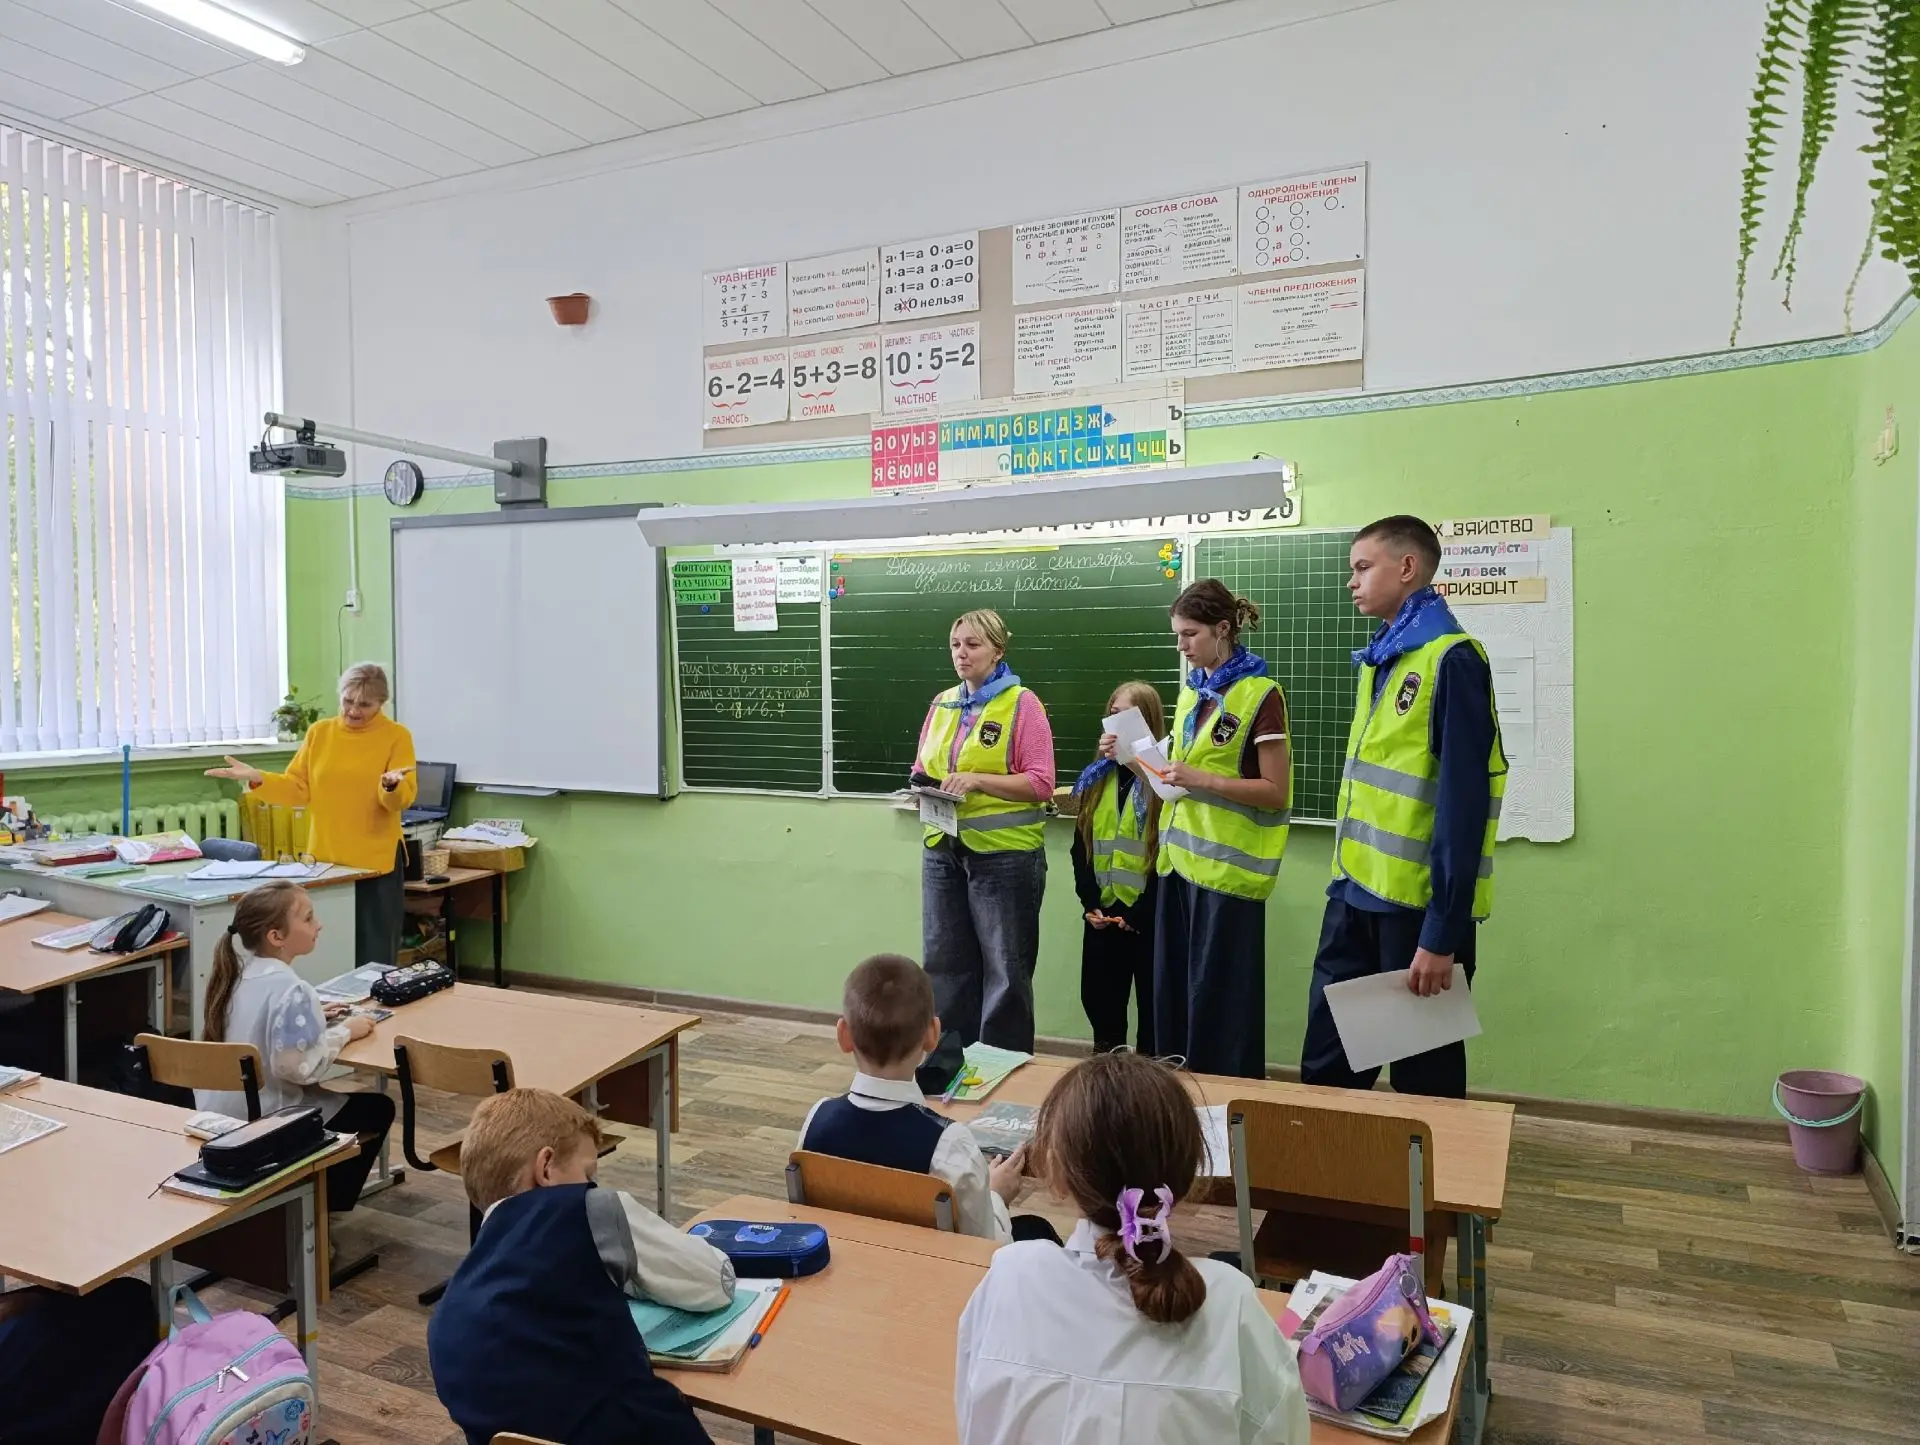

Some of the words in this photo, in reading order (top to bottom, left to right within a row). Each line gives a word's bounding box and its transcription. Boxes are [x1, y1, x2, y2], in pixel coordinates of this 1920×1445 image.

[1248, 181, 1317, 198] ОДНОРОДНЫЕ
[1320, 176, 1357, 187] ЧЛЕНЫ
[1264, 188, 1339, 205] ПРЕДЛОЖЕНИЯ
[1136, 204, 1177, 217] СОСТАВ
[1181, 196, 1218, 209] СЛОВА
[1016, 224, 1045, 234] ПАРНЫЕ
[1048, 219, 1080, 229] ЗВОНКИЕ
[1088, 214, 1115, 223] ГЛУХИЕ
[1016, 230, 1058, 241] СОГЛАСНЫЕ
[1066, 226, 1088, 234] КОРНЕ
[1091, 222, 1115, 230] СЛОВА
[713, 267, 777, 285] УРАВНЕНИЕ
[762, 279, 766, 287] 7
[1248, 287, 1281, 295] ЧЛЕНЫ
[1284, 278, 1357, 292] ПРЕДЛОЖЕНИЯ
[741, 305, 747, 313] 4
[804, 304, 834, 312] сколько
[921, 294, 964, 308] нельзя
[1140, 300, 1178, 309] ЧАСТИ
[1188, 293, 1219, 303] РЕЧИ
[805, 315, 833, 324] сколько
[1019, 313, 1063, 324] ПЕРЕНОСИ
[1065, 308, 1117, 318] ПРАВИЛЬНО
[949, 327, 974, 338] ЧАСТНОЕ
[886, 352, 910, 376] 10
[1048, 355, 1092, 365] ПЕРЕНОСИ
[895, 392, 937, 405] ЧАСТНОЕ
[802, 404, 835, 416] СУММА
[712, 414, 748, 424] РАЗНОСТЬ
[874, 437, 883, 451] а
[888, 436, 896, 450] о
[902, 433, 909, 453] у
[913, 432, 925, 447] ы
[928, 431, 936, 441] э
[942, 423, 950, 443] й
[955, 428, 964, 441] н
[968, 425, 980, 440] м
[999, 423, 1008, 443] р
[1013, 416, 1023, 435] б
[1028, 420, 1038, 435] в
[1044, 418, 1052, 434] г
[1058, 416, 1069, 436] д
[1073, 415, 1082, 430] з
[1088, 412, 1101, 428] ж
[874, 467, 883, 481] я
[887, 460, 896, 480] ё
[900, 464, 911, 479] ю
[914, 462, 922, 477] и
[928, 461, 936, 476] е
[1014, 453, 1023, 468] п
[1027, 448, 1039, 472] ф
[1043, 451, 1053, 466] к
[1060, 449, 1067, 464] т
[1074, 447, 1083, 463] с
[1088, 445, 1101, 462] ш
[1105, 444, 1115, 460] х
[1120, 443, 1131, 462] ц
[1137, 442, 1147, 456] ч
[1152, 440, 1166, 459] щ
[1262, 497, 1293, 520] 20
[1434, 518, 1533, 537] ХЗЯЙСТВО
[1443, 542, 1529, 557] пожалуйста
[674, 564, 726, 573] ПОВТОРИМ
[1049, 548, 1136, 582] сентября
[1444, 566, 1507, 577] человек
[674, 578, 727, 588] НАУЧИМСЯ
[920, 573, 1002, 593] Классная
[1013, 572, 1081, 607] работа
[680, 592, 716, 601] УЗНАЕМ
